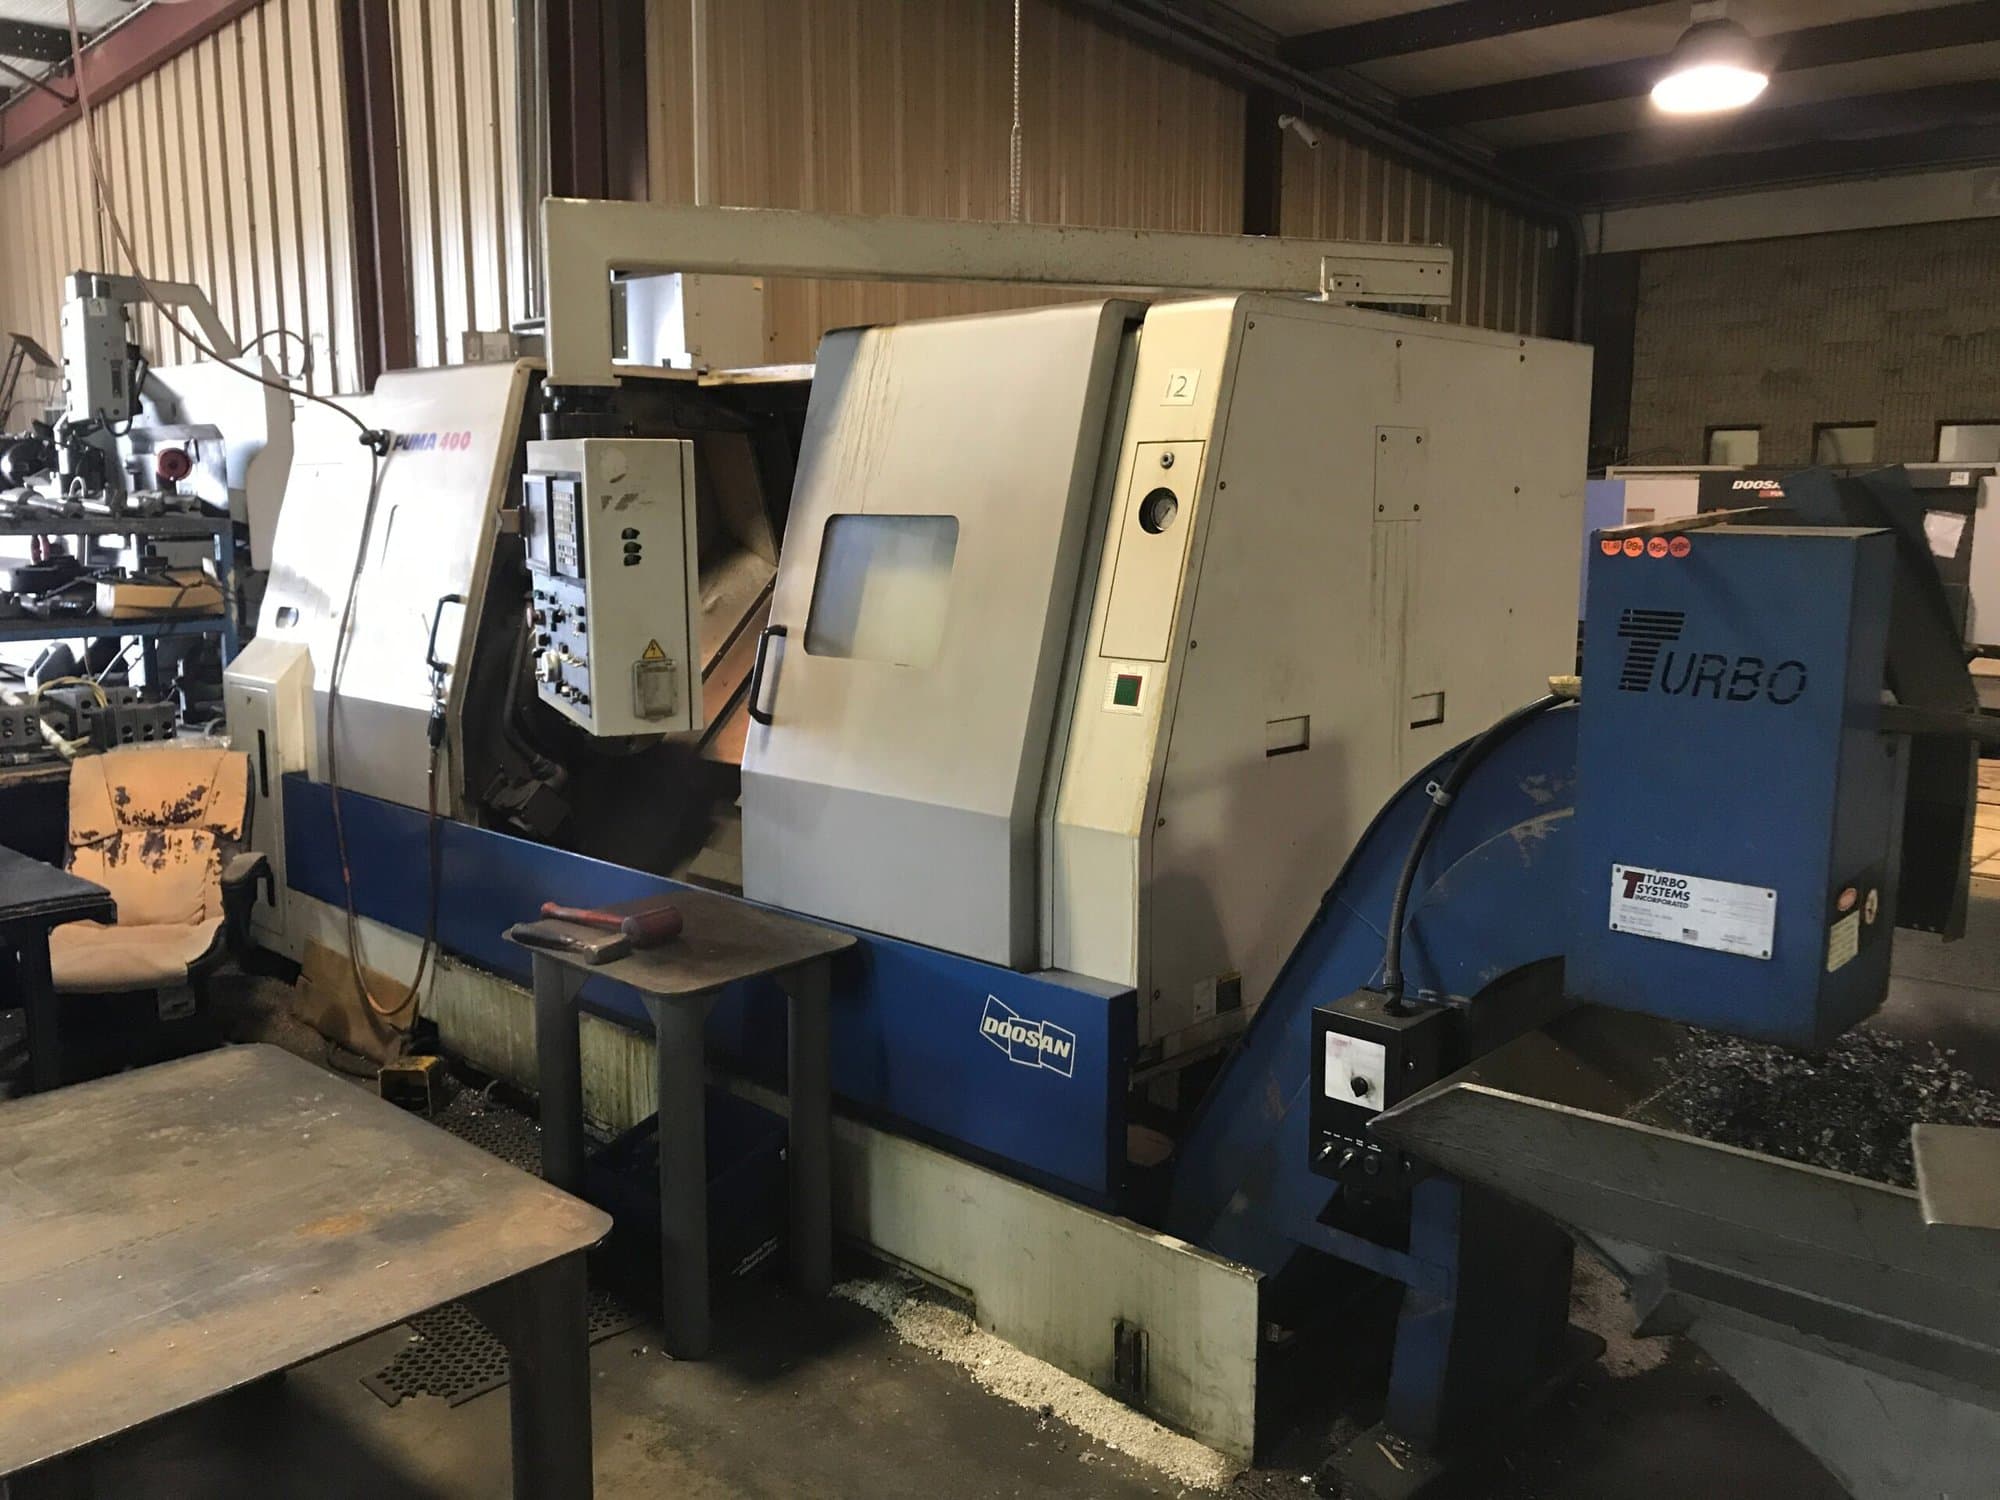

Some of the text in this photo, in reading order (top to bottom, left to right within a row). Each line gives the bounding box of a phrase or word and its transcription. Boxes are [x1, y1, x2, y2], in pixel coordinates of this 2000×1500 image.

[1173, 375, 1187, 398] 2
[392, 430, 471, 451] PUMA 400
[1617, 608, 1807, 705] TURBO
[1646, 874, 1687, 889] TURBO
[1635, 894, 1689, 909] INCORPORATED
[1636, 884, 1691, 901] SYSTEMS
[983, 1016, 1071, 1058] DOOSAN
